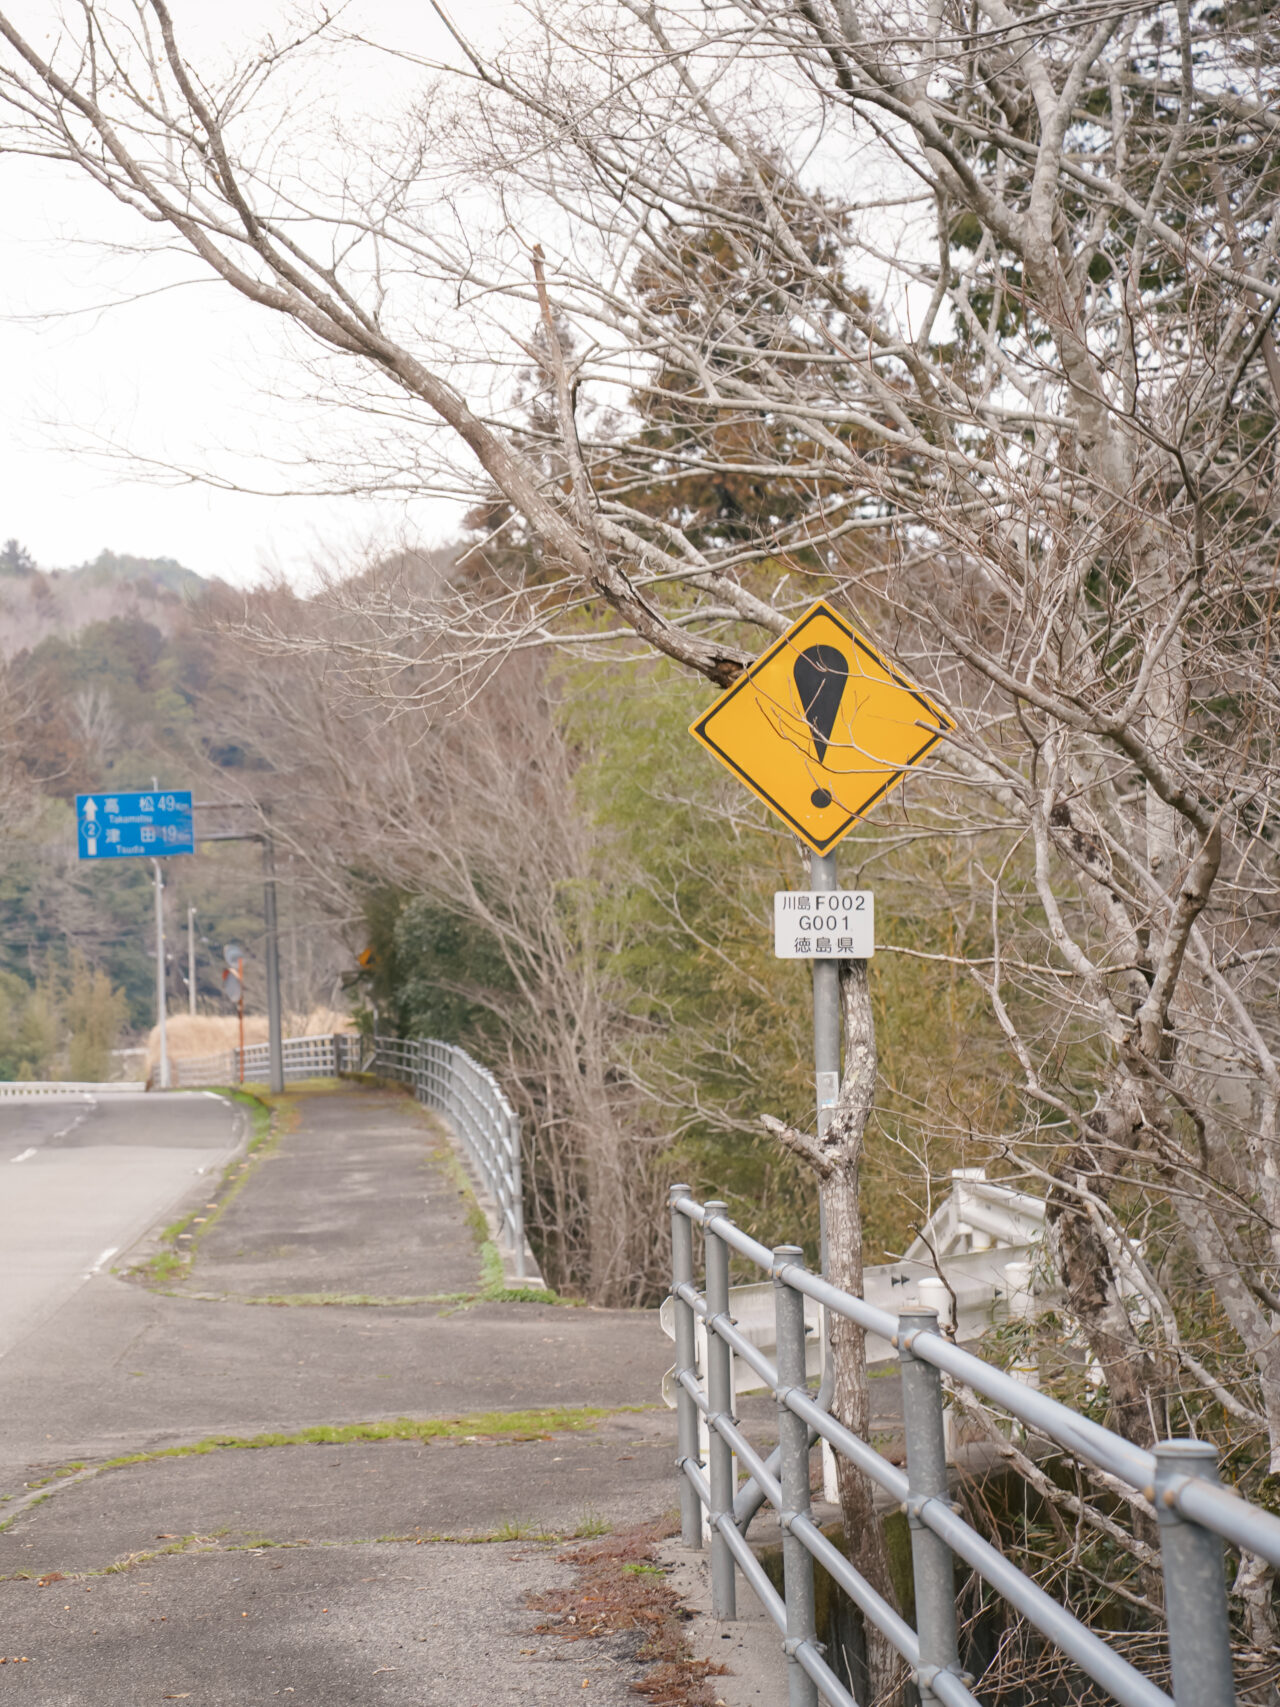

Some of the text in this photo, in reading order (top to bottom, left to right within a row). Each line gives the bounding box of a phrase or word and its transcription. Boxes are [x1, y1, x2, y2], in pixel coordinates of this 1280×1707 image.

[87, 824, 95, 836] 2
[799, 915, 848, 931] G001
[794, 937, 854, 953] 徳島県
